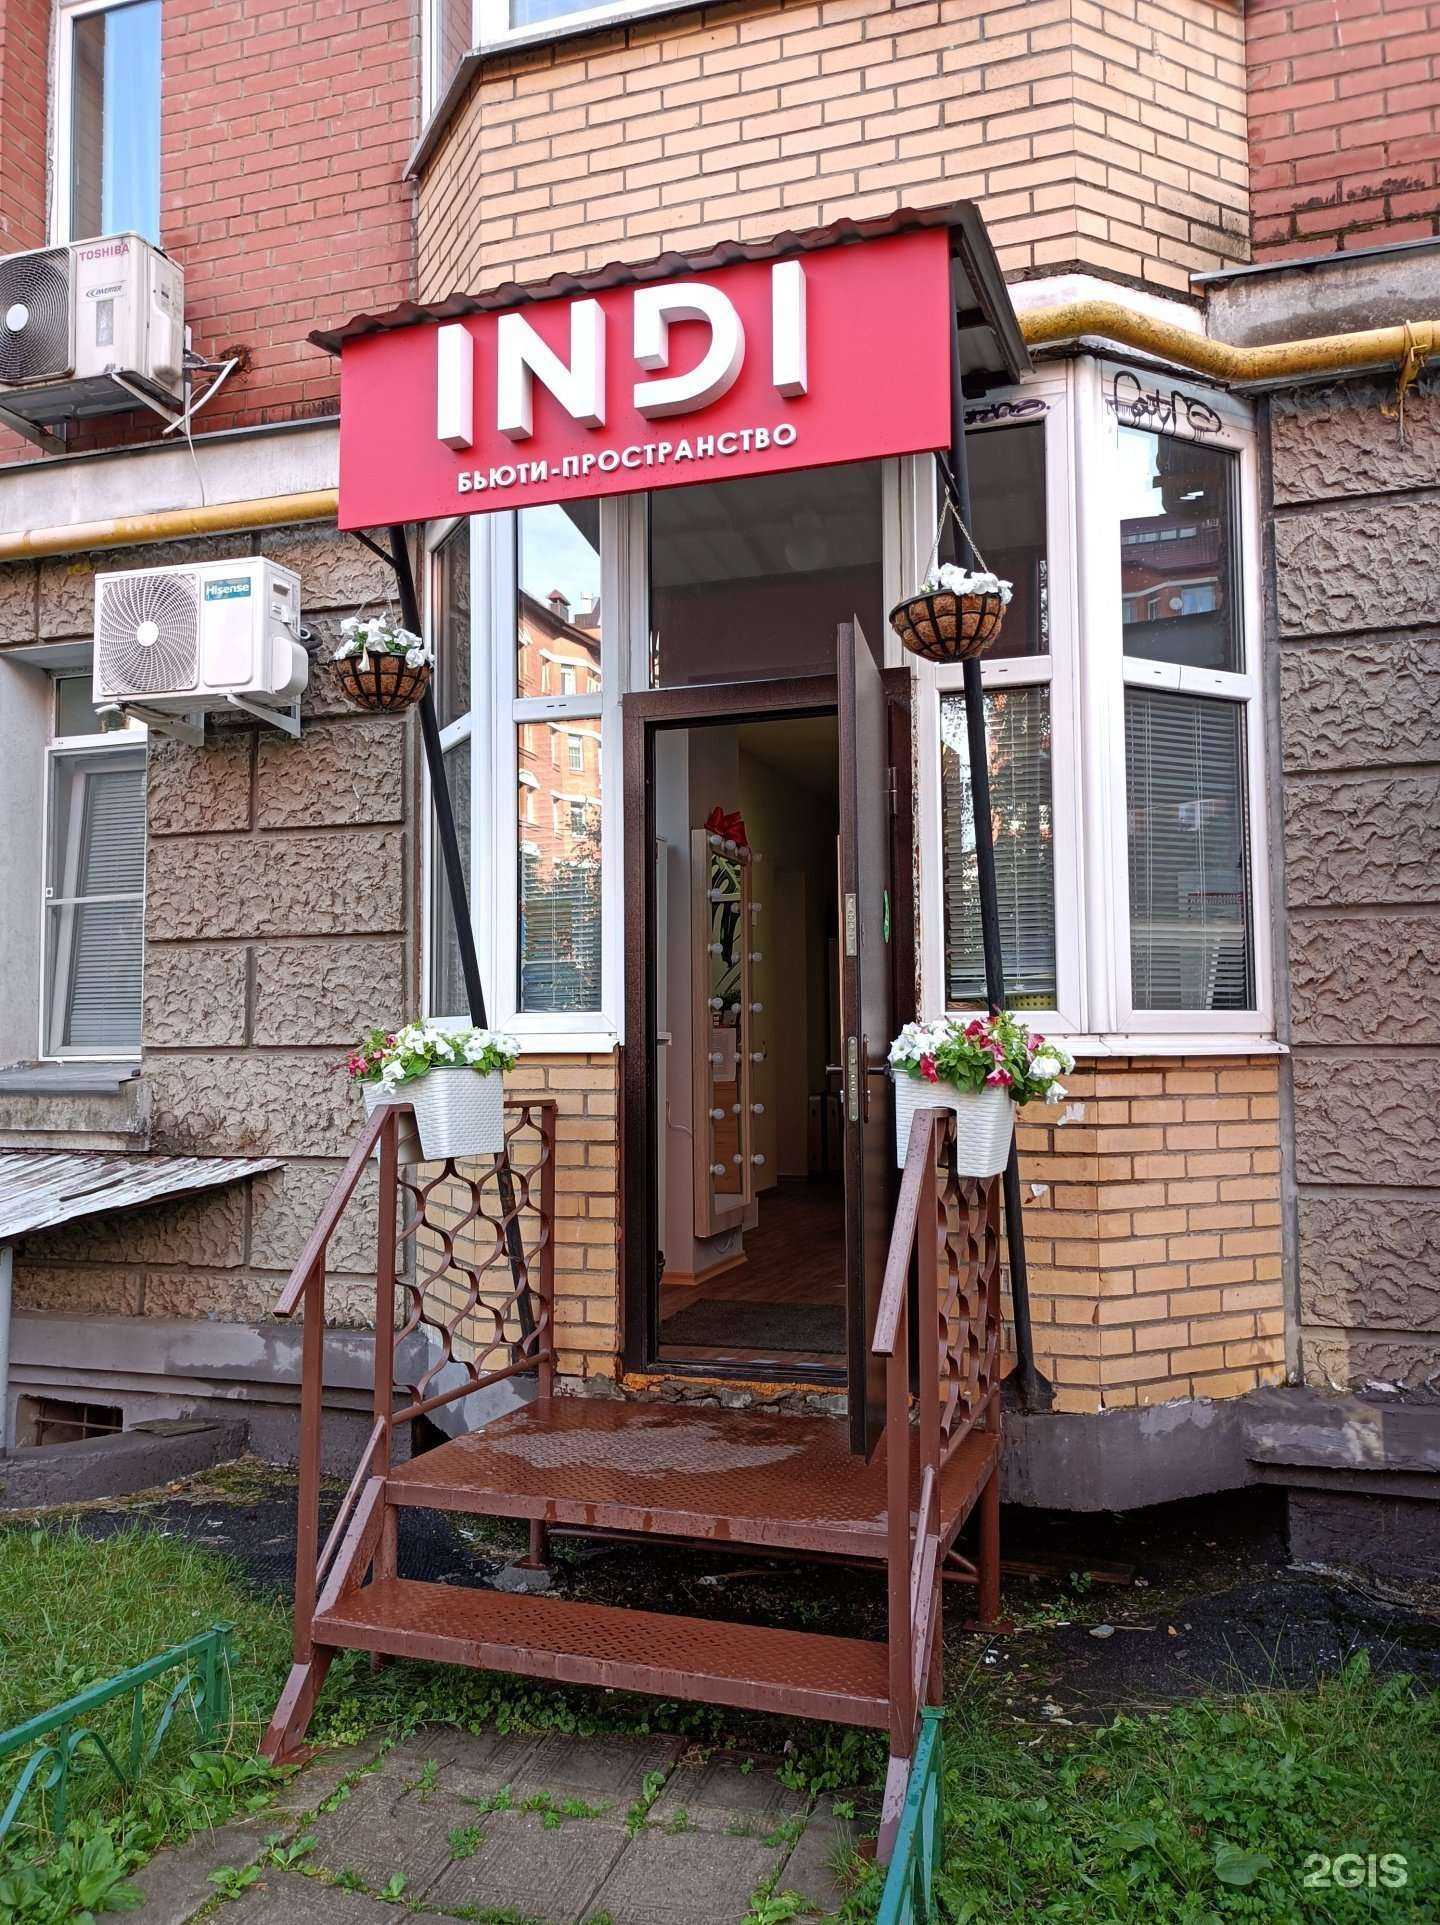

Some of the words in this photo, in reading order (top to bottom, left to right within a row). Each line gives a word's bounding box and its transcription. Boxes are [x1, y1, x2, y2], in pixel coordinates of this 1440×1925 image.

[79, 244, 130, 261] TOSHIBA
[437, 260, 808, 450] INDI
[457, 423, 798, 494] БЬЮТИ-ПРОСТРАНСТВО
[207, 584, 249, 595] Hisense
